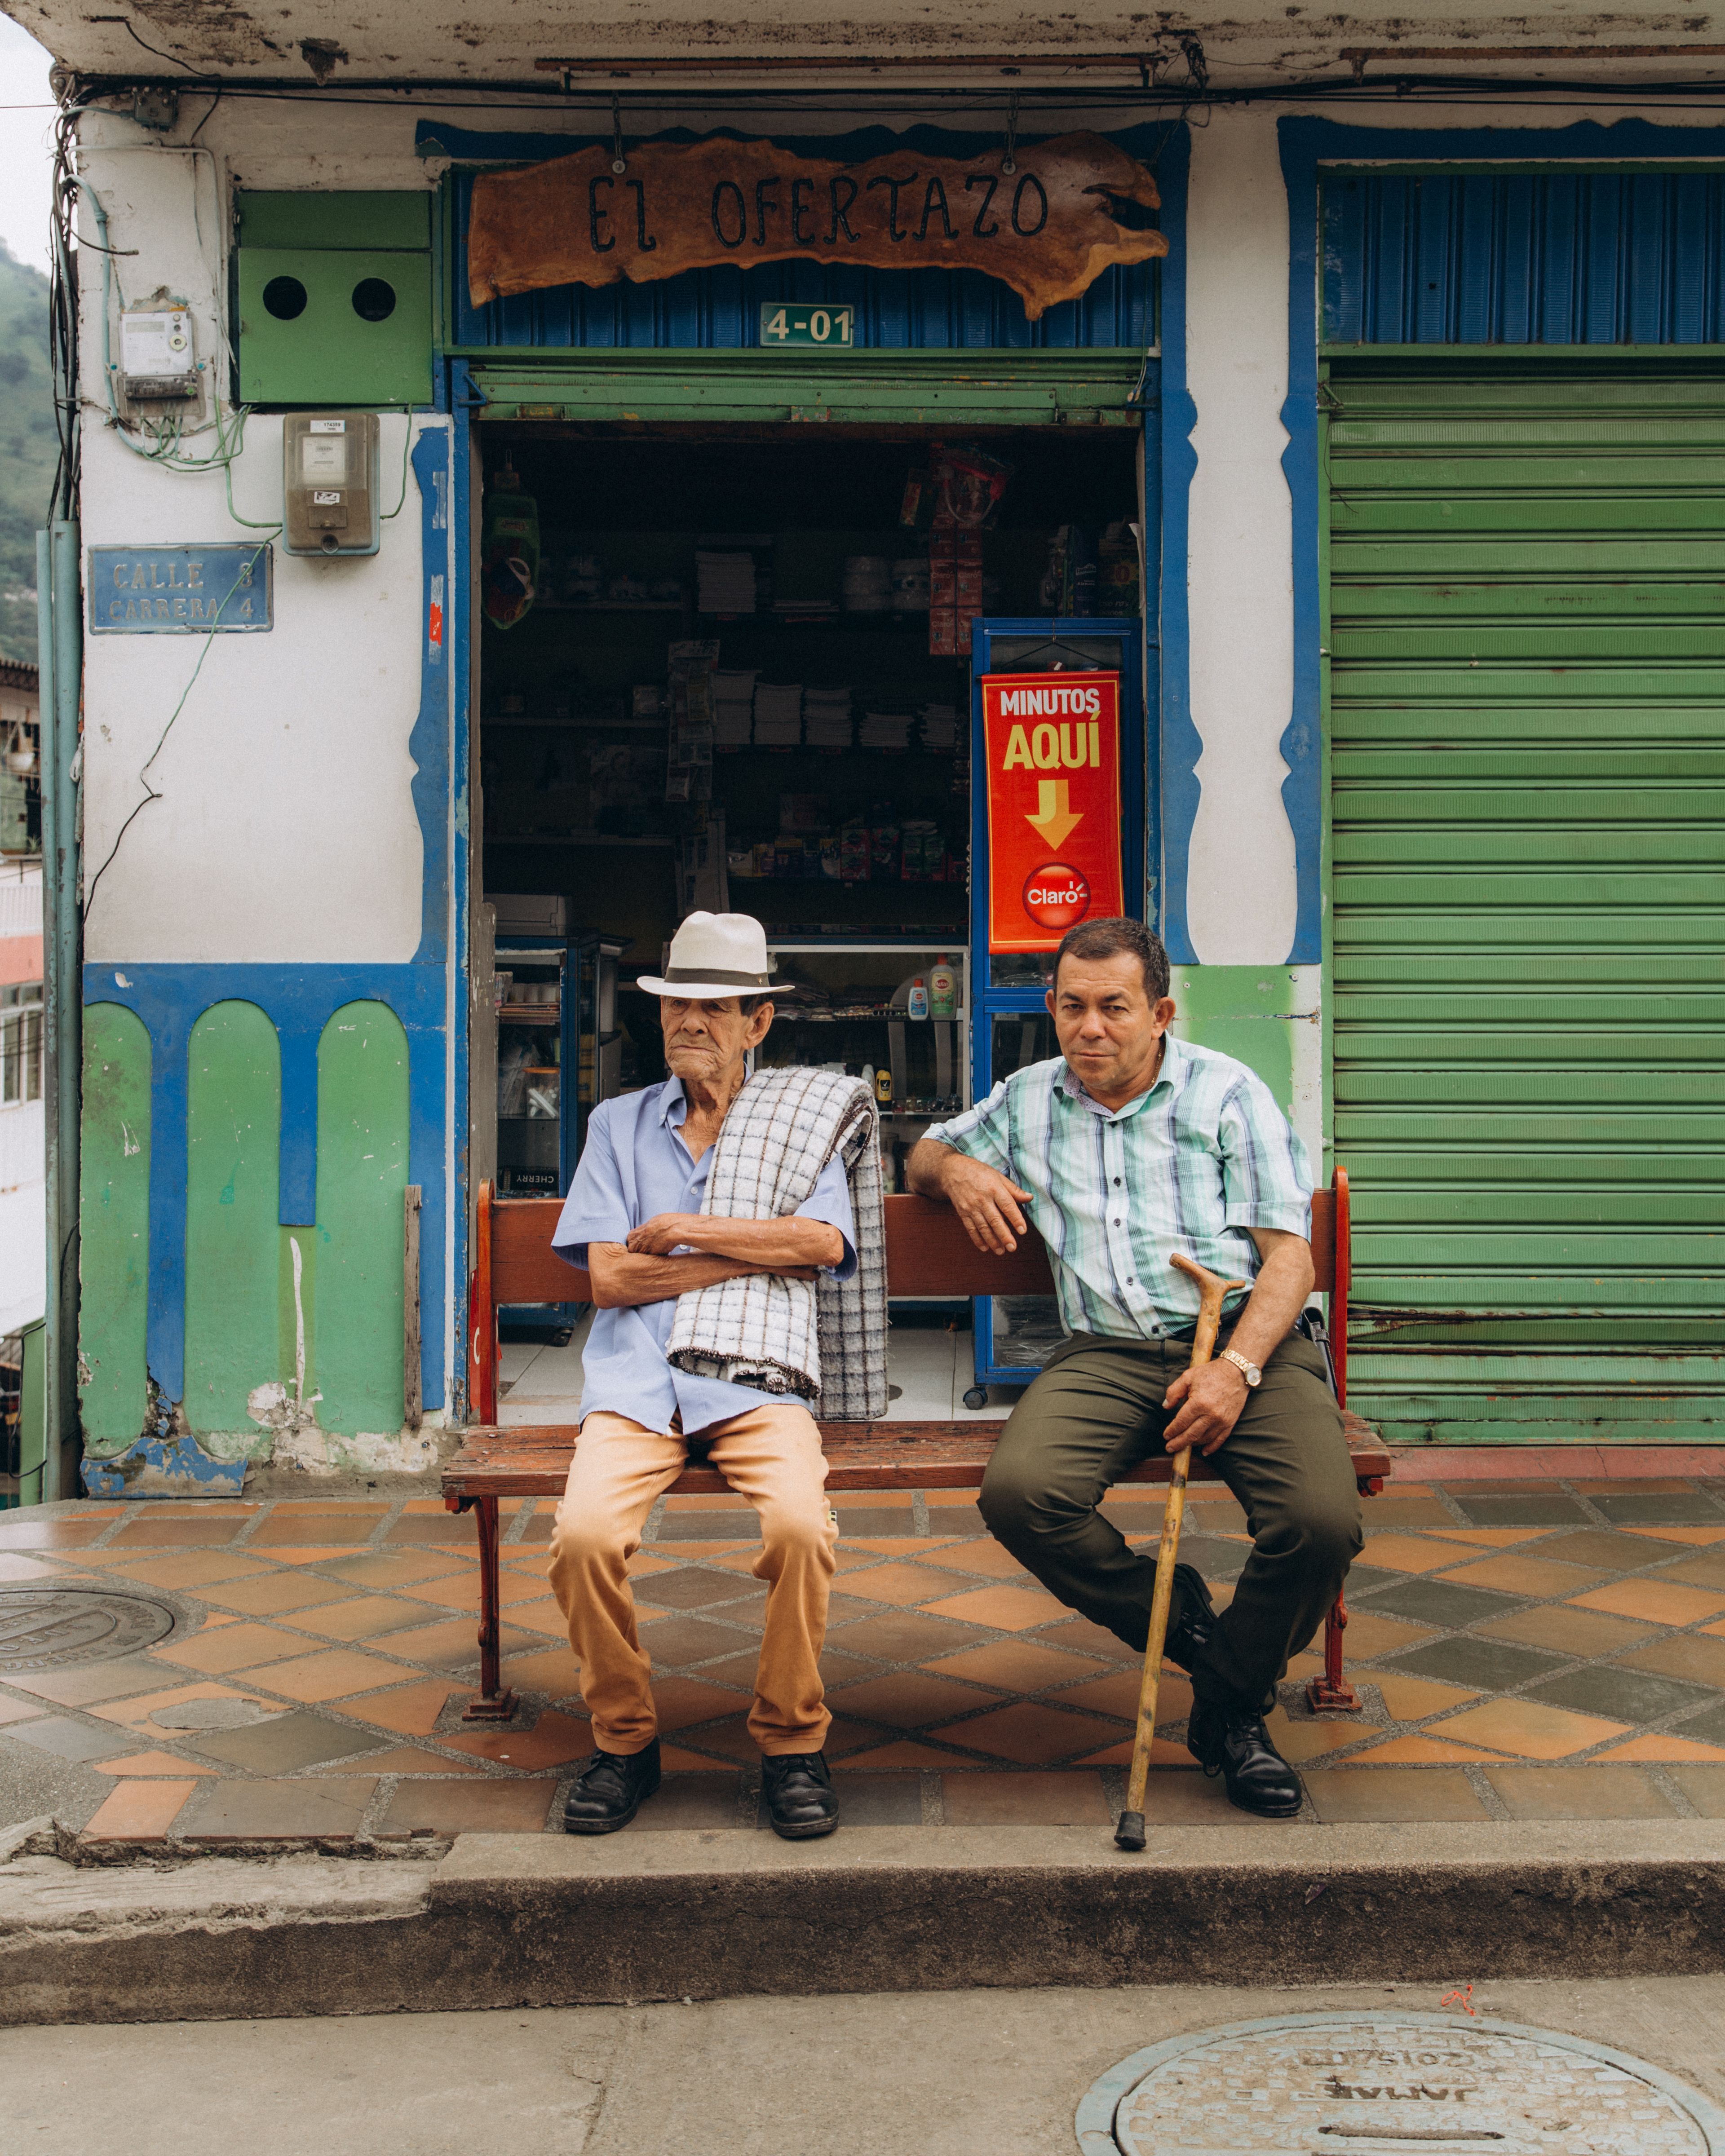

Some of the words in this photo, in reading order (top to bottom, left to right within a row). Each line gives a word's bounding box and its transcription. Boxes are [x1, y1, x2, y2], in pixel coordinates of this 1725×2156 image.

[712, 171, 1047, 248] OFERTAZO
[767, 309, 851, 341] 4-01
[113, 563, 203, 589] CALLE
[109, 598, 218, 621] CARRERA
[240, 598, 254, 619] 4
[1001, 688, 1100, 716] MINUTOS
[1003, 711, 1101, 770] AQUÍ
[1027, 884, 1080, 905] Claro
[517, 1175, 554, 1183] CHERRY
